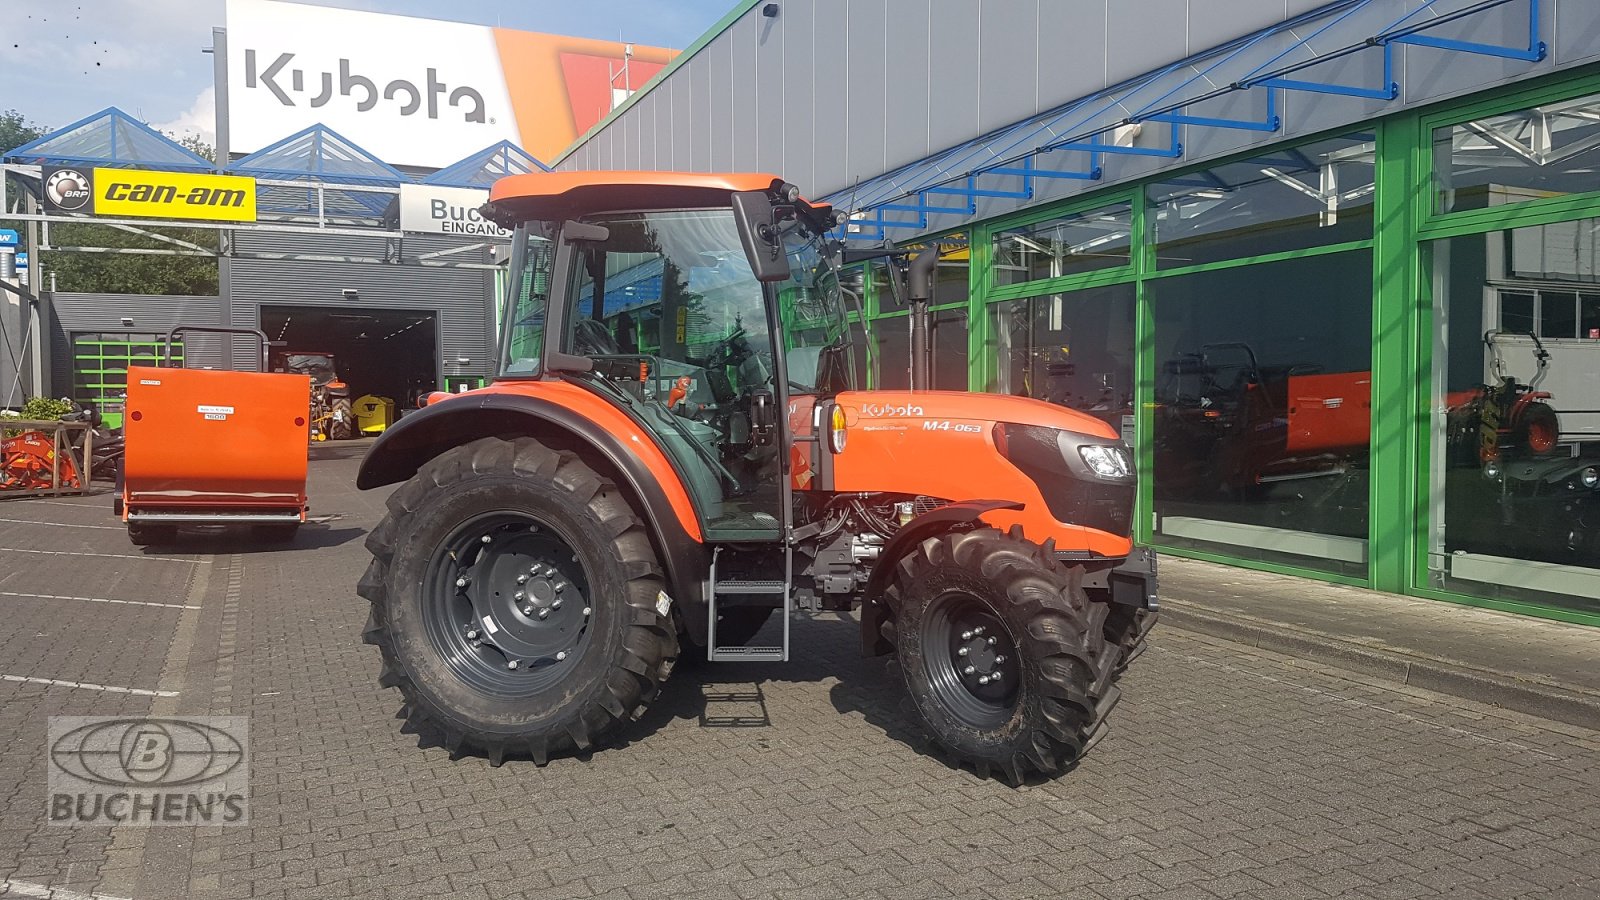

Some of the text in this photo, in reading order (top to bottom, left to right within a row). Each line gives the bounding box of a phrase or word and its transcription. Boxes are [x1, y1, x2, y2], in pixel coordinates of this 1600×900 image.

[244, 48, 486, 124] Kubota
[64, 189, 89, 199] BRP
[104, 182, 247, 208] can-am
[430, 198, 489, 223] Buc
[441, 220, 507, 236] EINGANG
[862, 403, 924, 417] Kubota
[922, 420, 982, 433] M4-063
